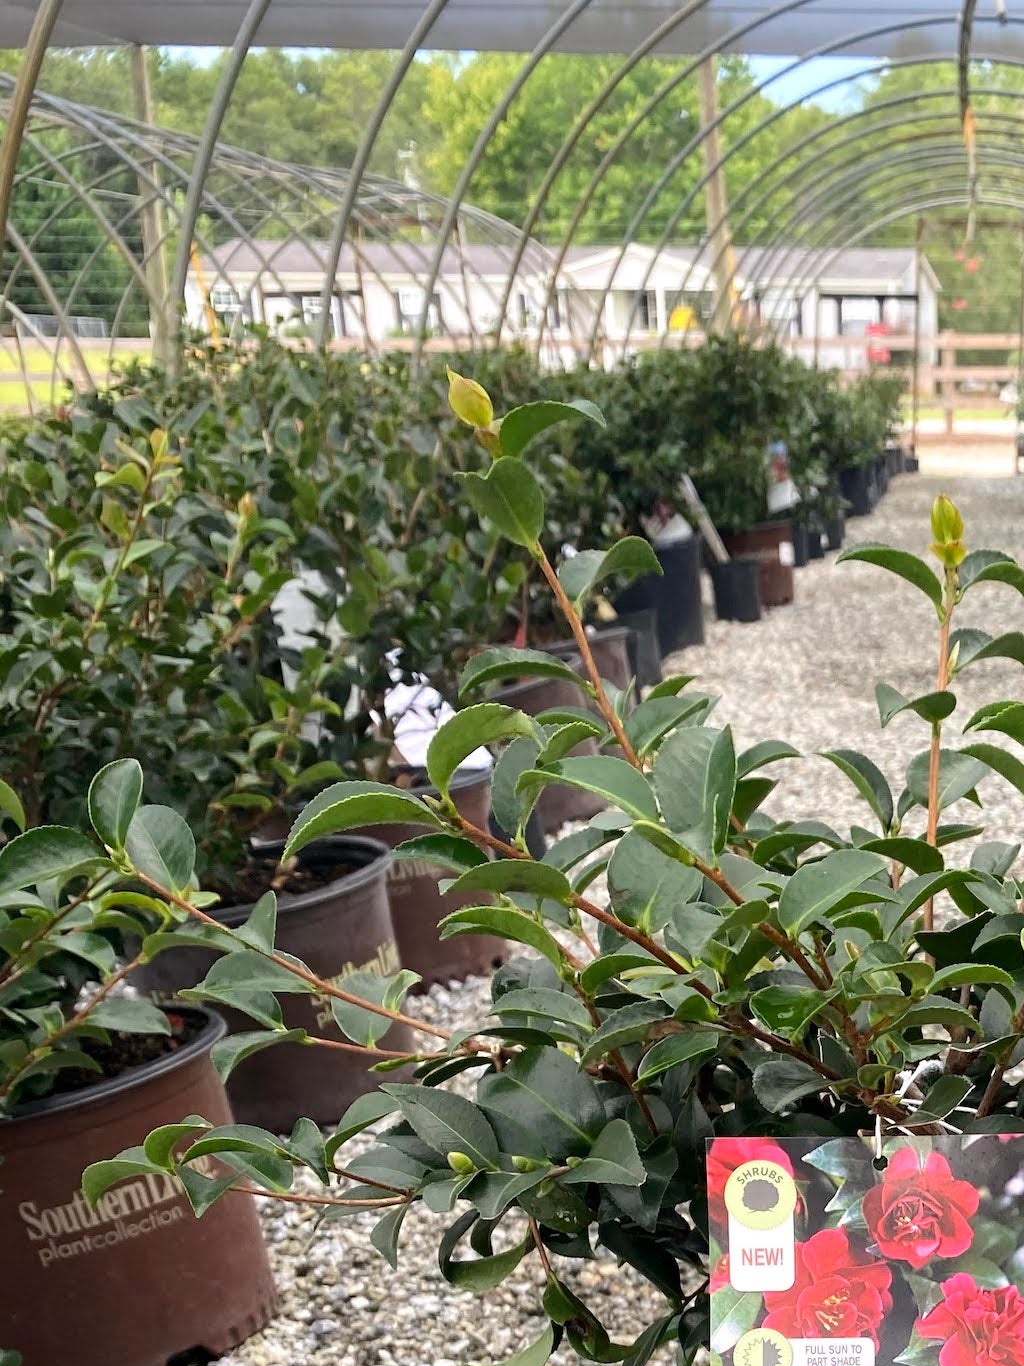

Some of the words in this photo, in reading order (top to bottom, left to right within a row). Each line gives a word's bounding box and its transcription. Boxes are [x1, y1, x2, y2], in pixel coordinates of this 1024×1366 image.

[737, 1167, 783, 1185] SHRUBS
[742, 1248, 784, 1266] NEW!
[805, 1345, 826, 1355] FULL
[828, 1344, 848, 1355] SUN
[851, 1344, 863, 1354] TO
[807, 1357, 828, 1366] PART
[830, 1356, 861, 1366] SHADE
